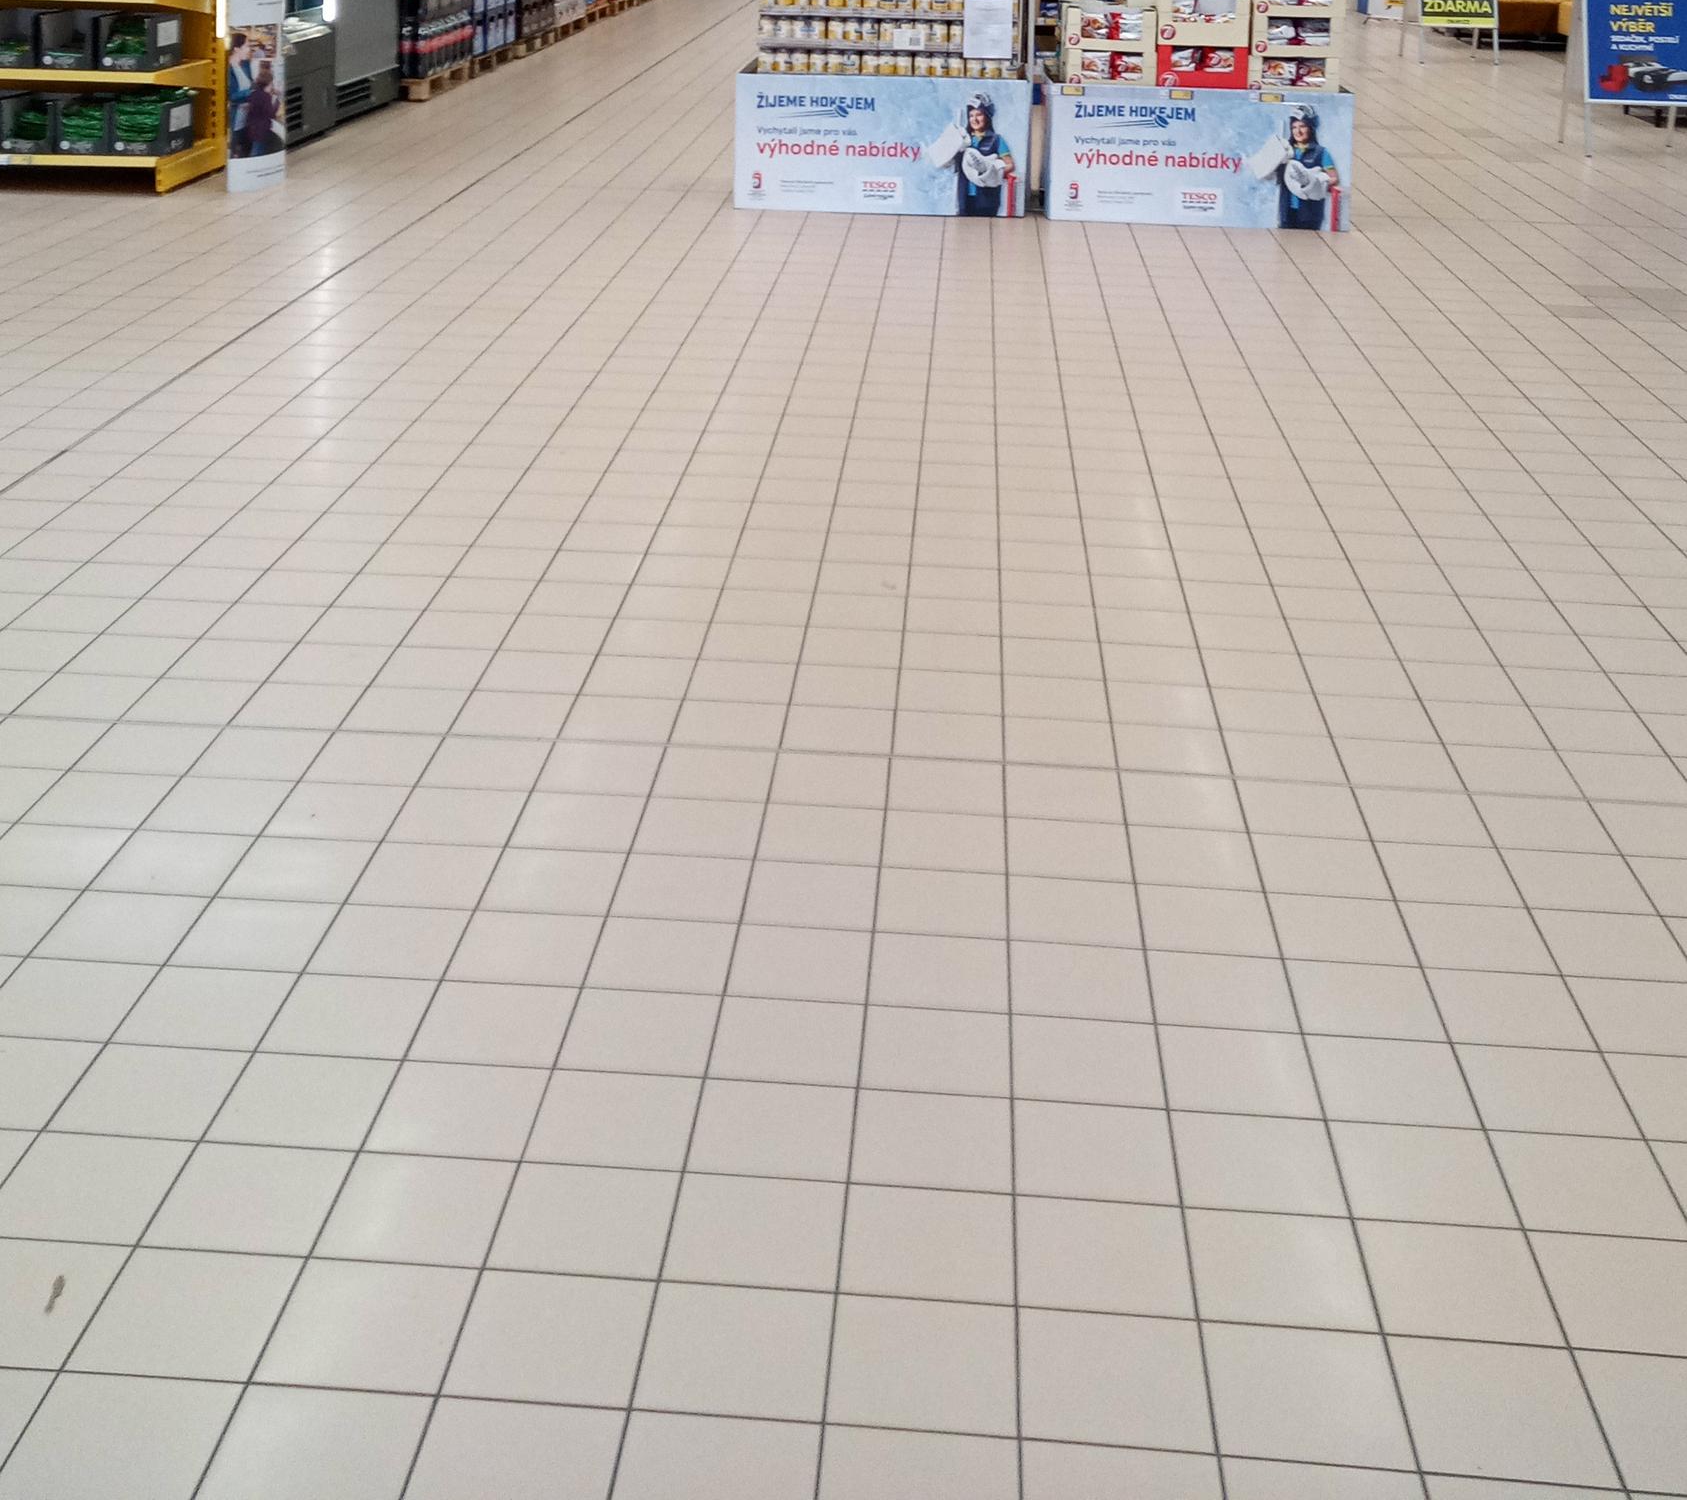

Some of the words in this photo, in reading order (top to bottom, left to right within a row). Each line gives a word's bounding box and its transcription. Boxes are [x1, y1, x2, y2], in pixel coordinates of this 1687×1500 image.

[1423, 0, 1492, 14] ZDARMA
[1609, 2, 1674, 17] NEJVĚTŠÍ
[1609, 18, 1655, 33] VÝBĚR
[756, 92, 806, 110] ŽIJEME
[809, 95, 875, 111] HOKEJEM
[1074, 103, 1125, 119] ŽIJEME
[1129, 105, 1196, 122] HOKEJEM
[756, 139, 839, 158] výhodné
[845, 142, 921, 162] nabídky
[1074, 149, 1159, 169] výhodné
[1165, 152, 1242, 173] nabídky
